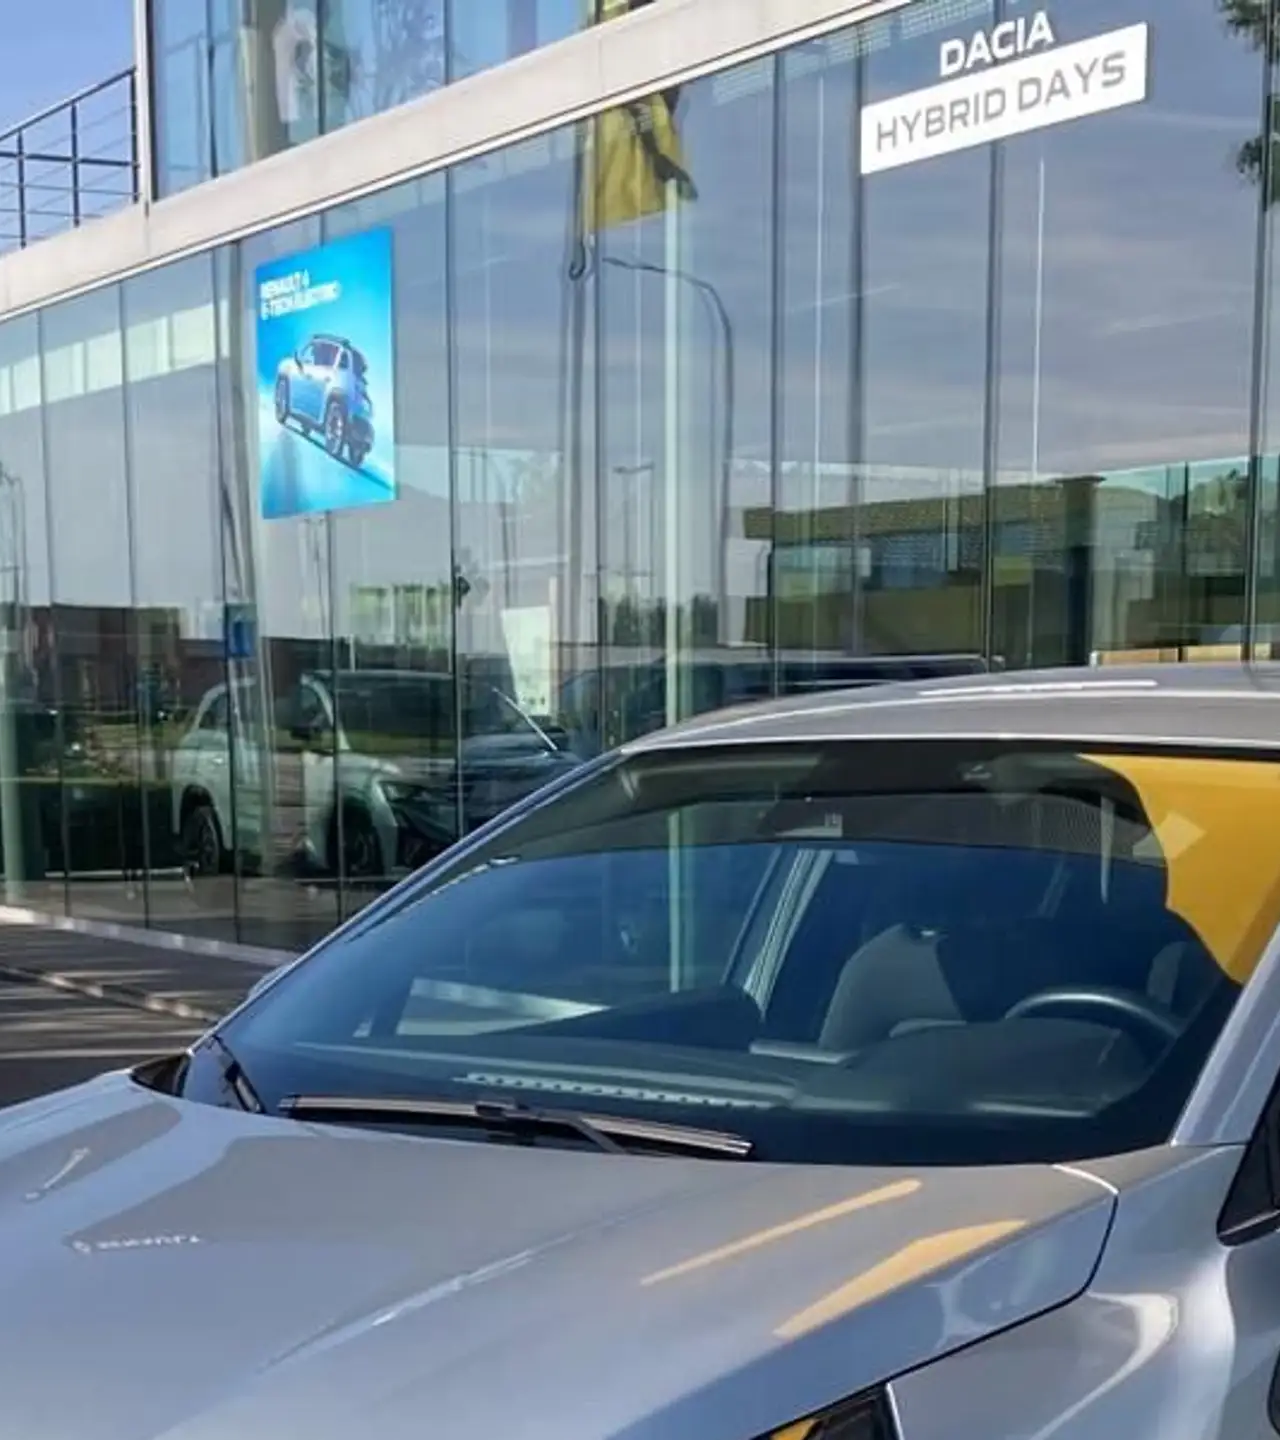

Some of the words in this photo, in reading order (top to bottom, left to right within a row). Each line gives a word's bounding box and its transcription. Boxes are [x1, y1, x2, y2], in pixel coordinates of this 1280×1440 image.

[939, 10, 1056, 77] DACIA
[876, 87, 1006, 152] HYBRID
[1017, 50, 1126, 111] DAYS
